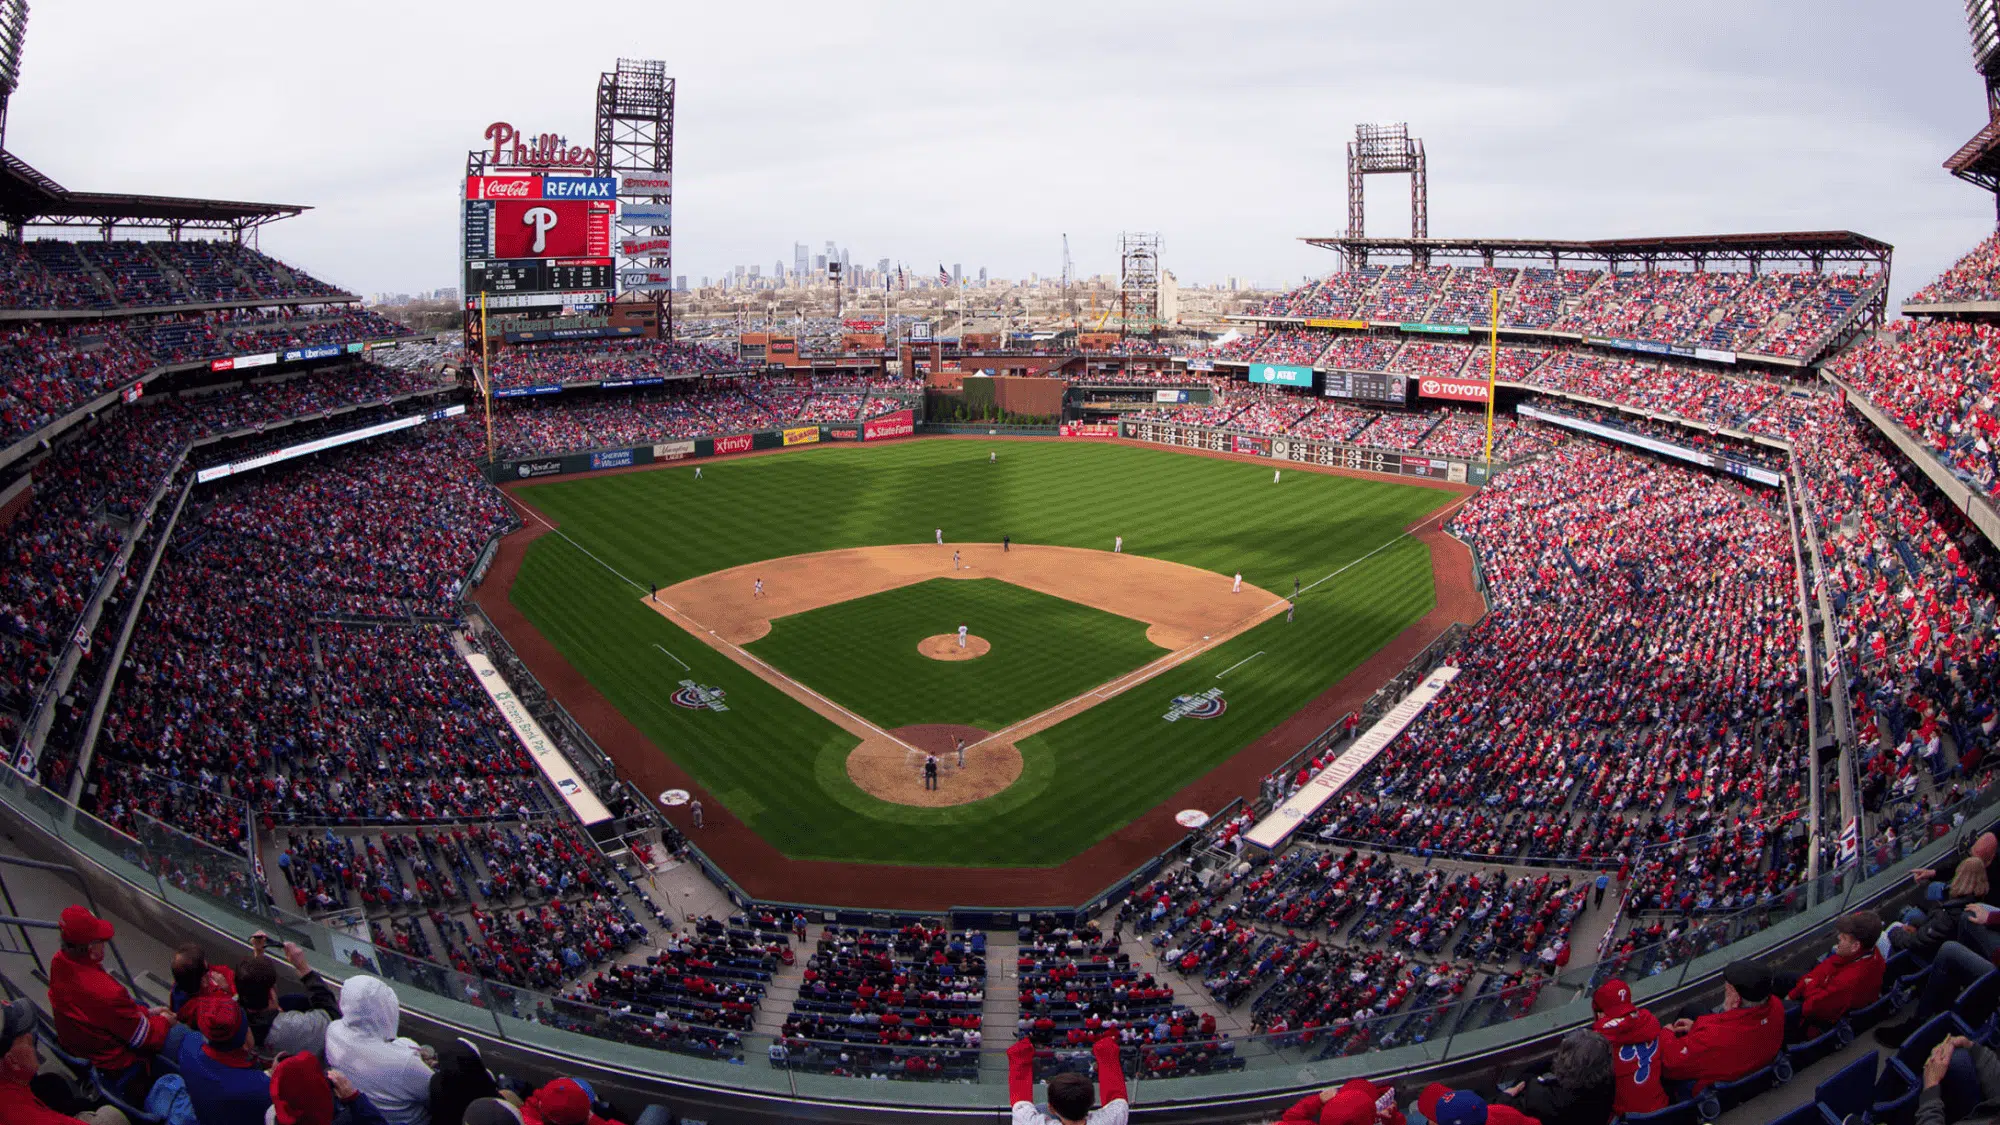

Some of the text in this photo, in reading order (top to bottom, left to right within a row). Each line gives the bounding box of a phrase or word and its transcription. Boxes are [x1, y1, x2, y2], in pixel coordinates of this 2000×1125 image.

[484, 121, 598, 166] Phillies
[486, 180, 531, 197] Coca-Cola
[546, 181, 611, 197] RE/MAX
[635, 180, 669, 188] TOYOTA
[523, 206, 558, 253] P
[504, 314, 609, 333] Citizens Bank Park
[1277, 369, 1297, 381] AT&T
[1442, 382, 1488, 397] TOYOTA
[877, 423, 913, 438] State Farm
[716, 437, 750, 452] xfinity
[601, 451, 630, 460] SHERWIN
[601, 457, 632, 468] WILLIAMS
[664, 452, 684, 461] LAGER
[530, 461, 561, 472] NovaCare
[1314, 699, 1425, 789] PHILADELPHIA PHILLIES
